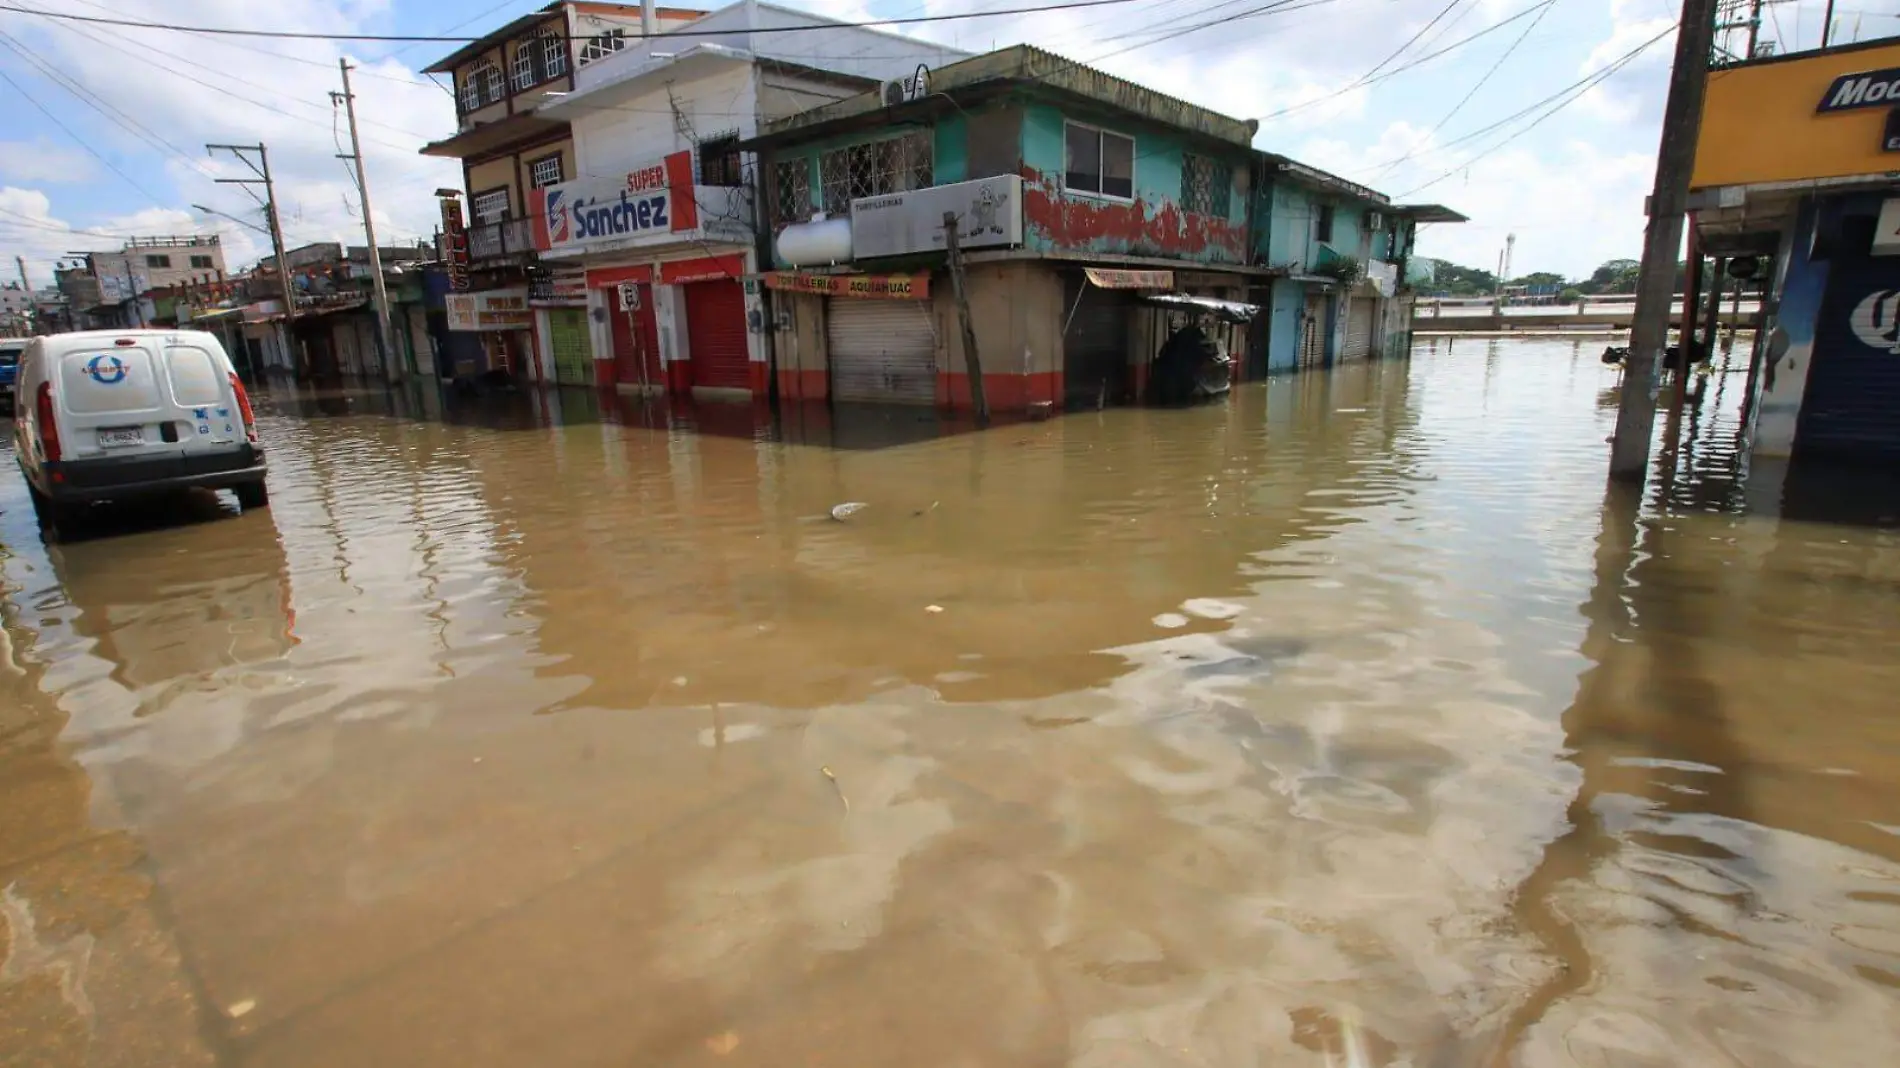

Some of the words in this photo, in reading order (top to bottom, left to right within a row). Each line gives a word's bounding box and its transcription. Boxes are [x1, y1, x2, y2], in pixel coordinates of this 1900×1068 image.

[627, 165, 664, 193] SUPER
[573, 189, 668, 239] Sánchez
[776, 274, 839, 291] TORTILLERIAS
[850, 281, 911, 294] AQUIAHUAC
